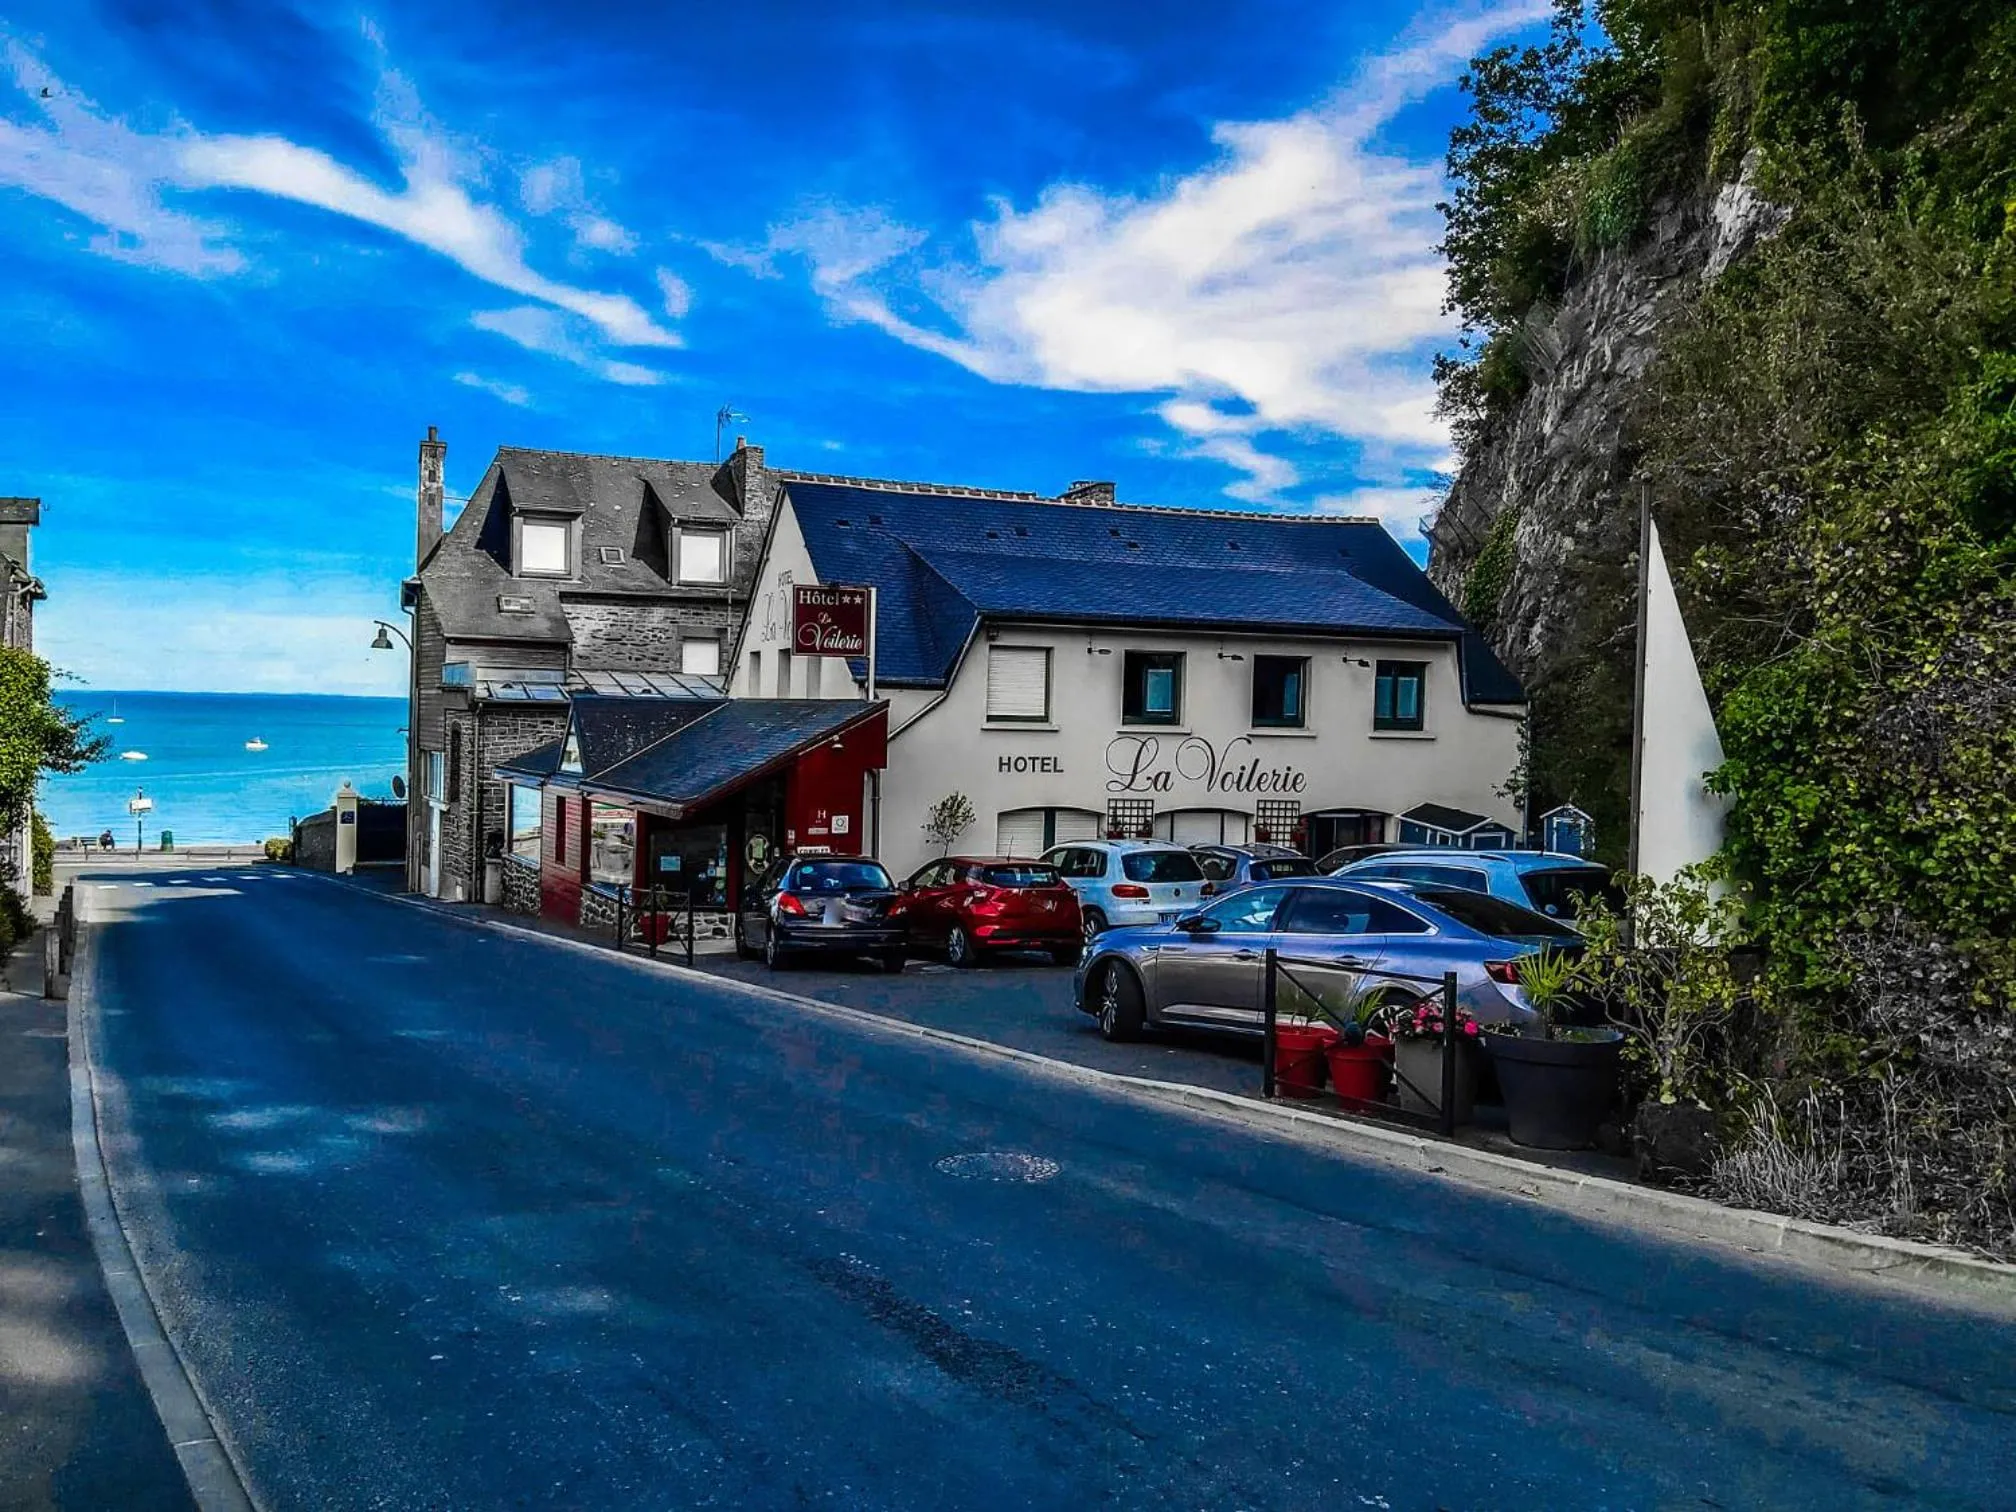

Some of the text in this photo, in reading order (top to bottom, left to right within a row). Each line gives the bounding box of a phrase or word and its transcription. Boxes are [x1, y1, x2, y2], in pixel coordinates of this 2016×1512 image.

[800, 590, 839, 606] Hôtel
[798, 622, 862, 651] Voilerie
[998, 756, 1064, 773] HOTEL
[1105, 736, 1307, 793] La Voilerie
